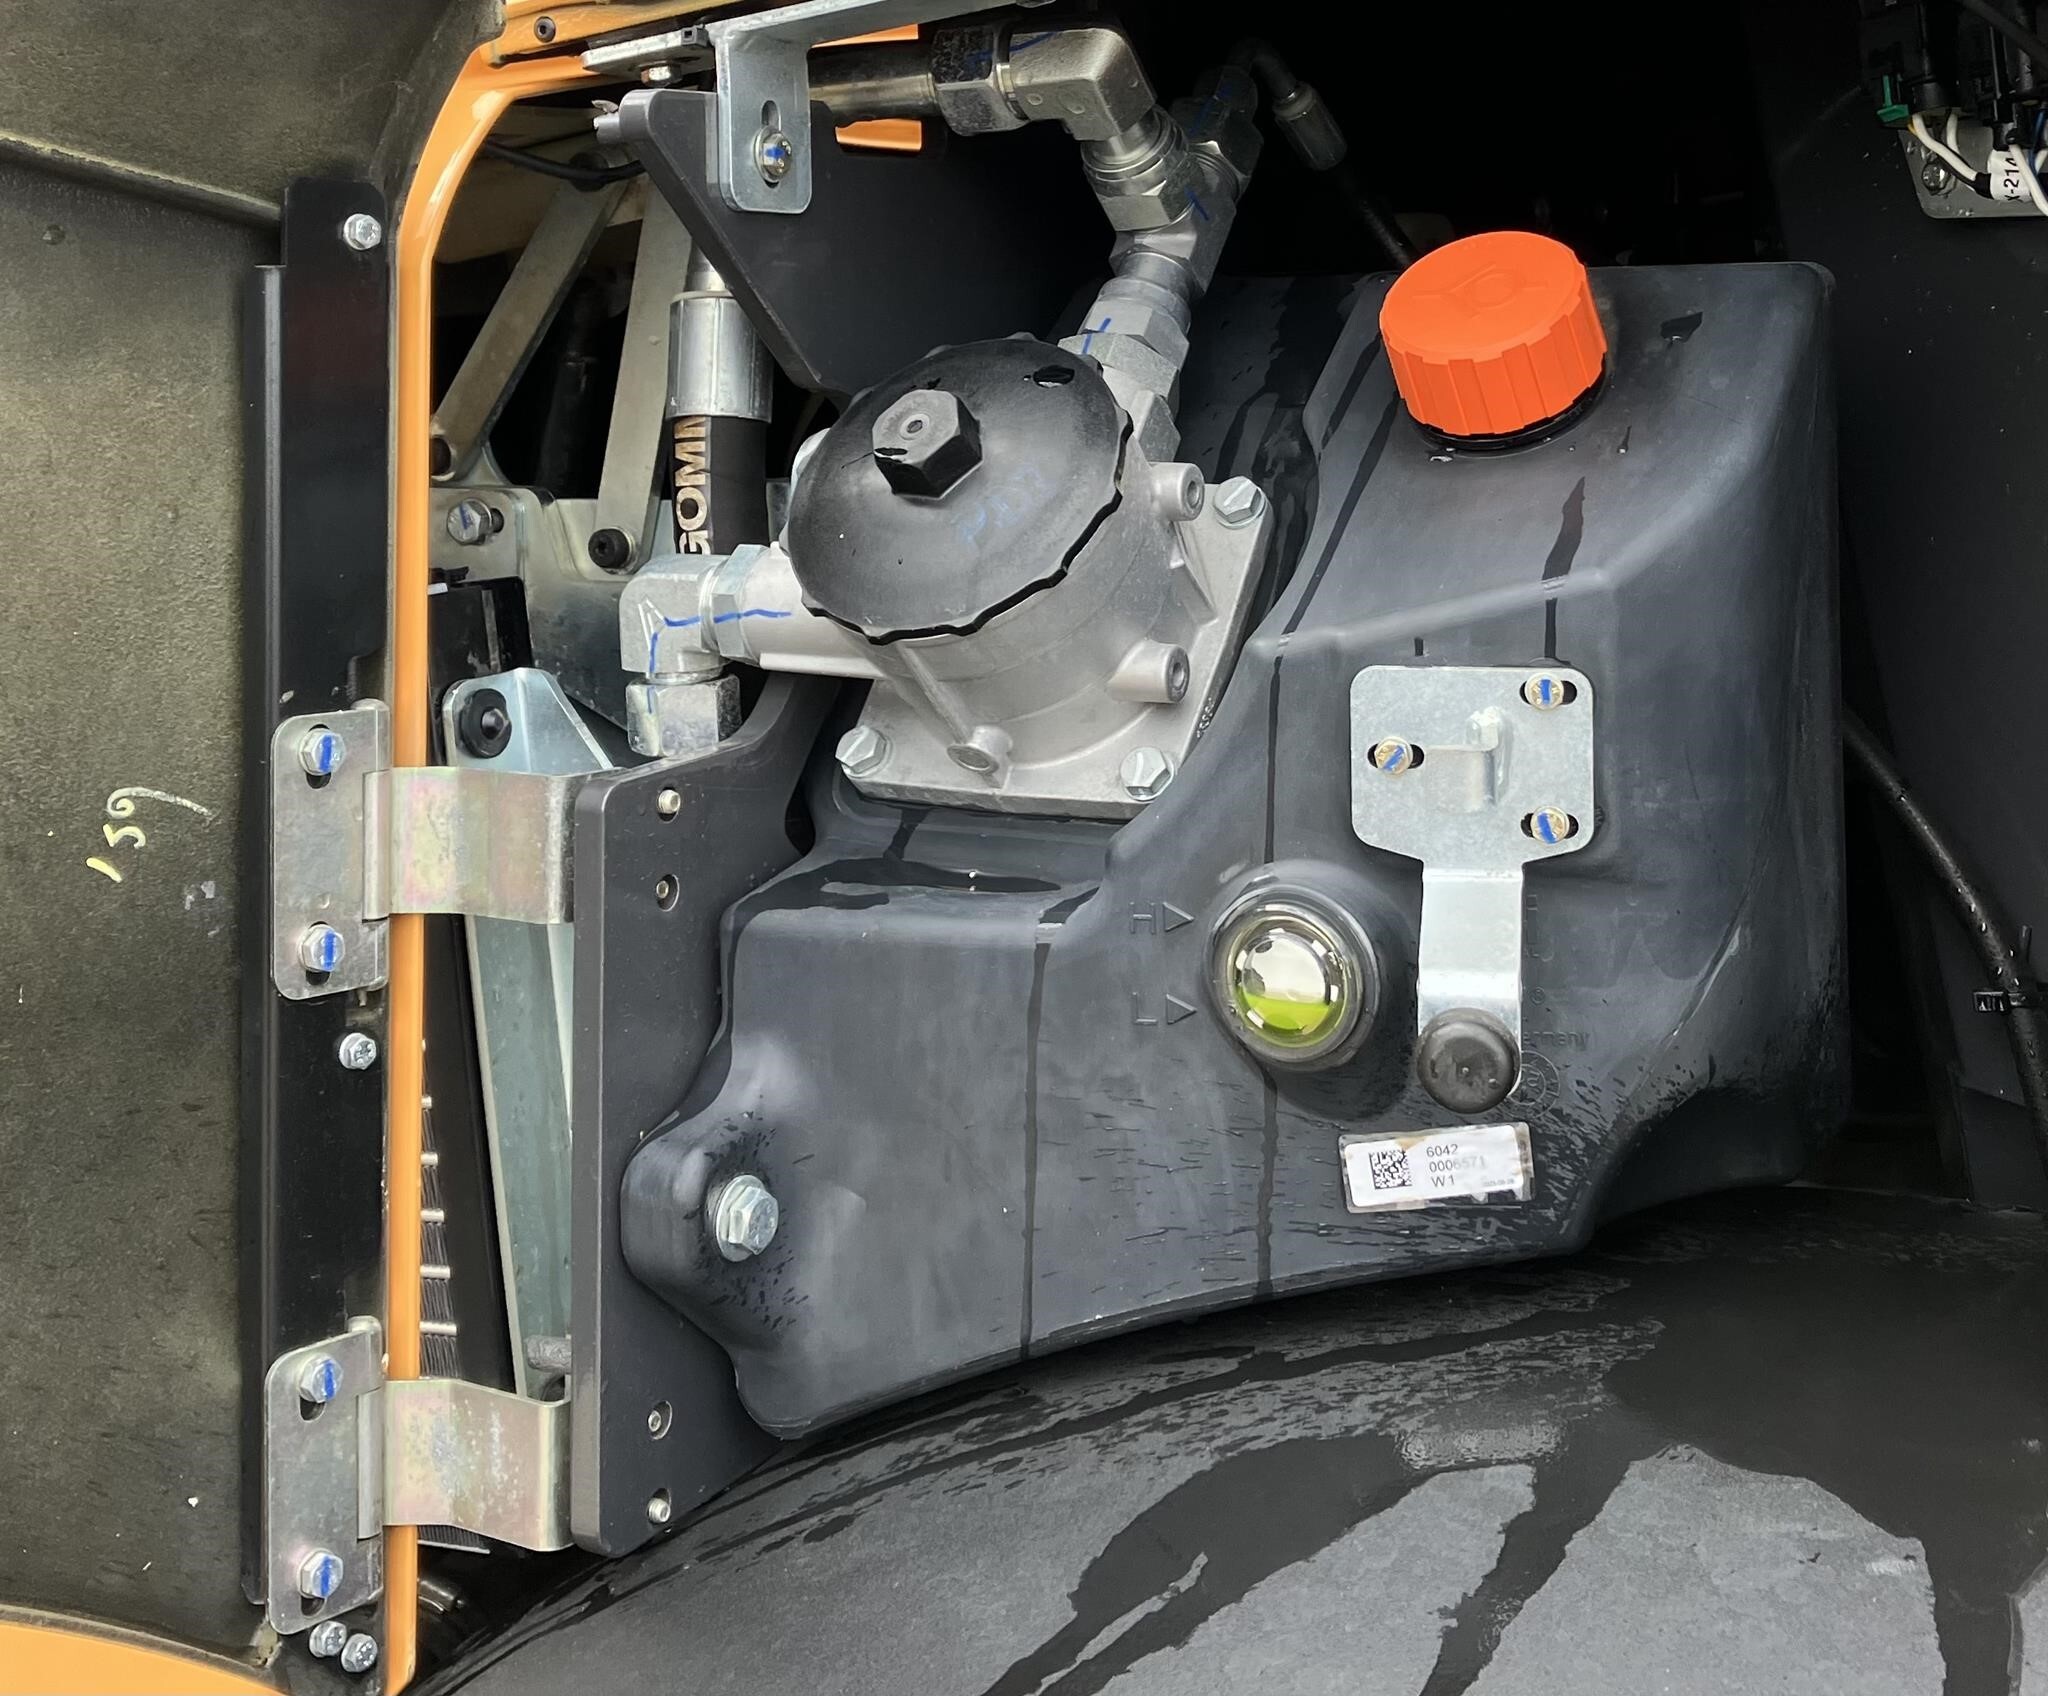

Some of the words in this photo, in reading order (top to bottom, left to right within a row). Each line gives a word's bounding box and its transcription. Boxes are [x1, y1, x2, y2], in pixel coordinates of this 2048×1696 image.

[1129, 902, 1156, 935] H
[1131, 992, 1159, 1025] L
[1426, 1143, 1458, 1158] 6042
